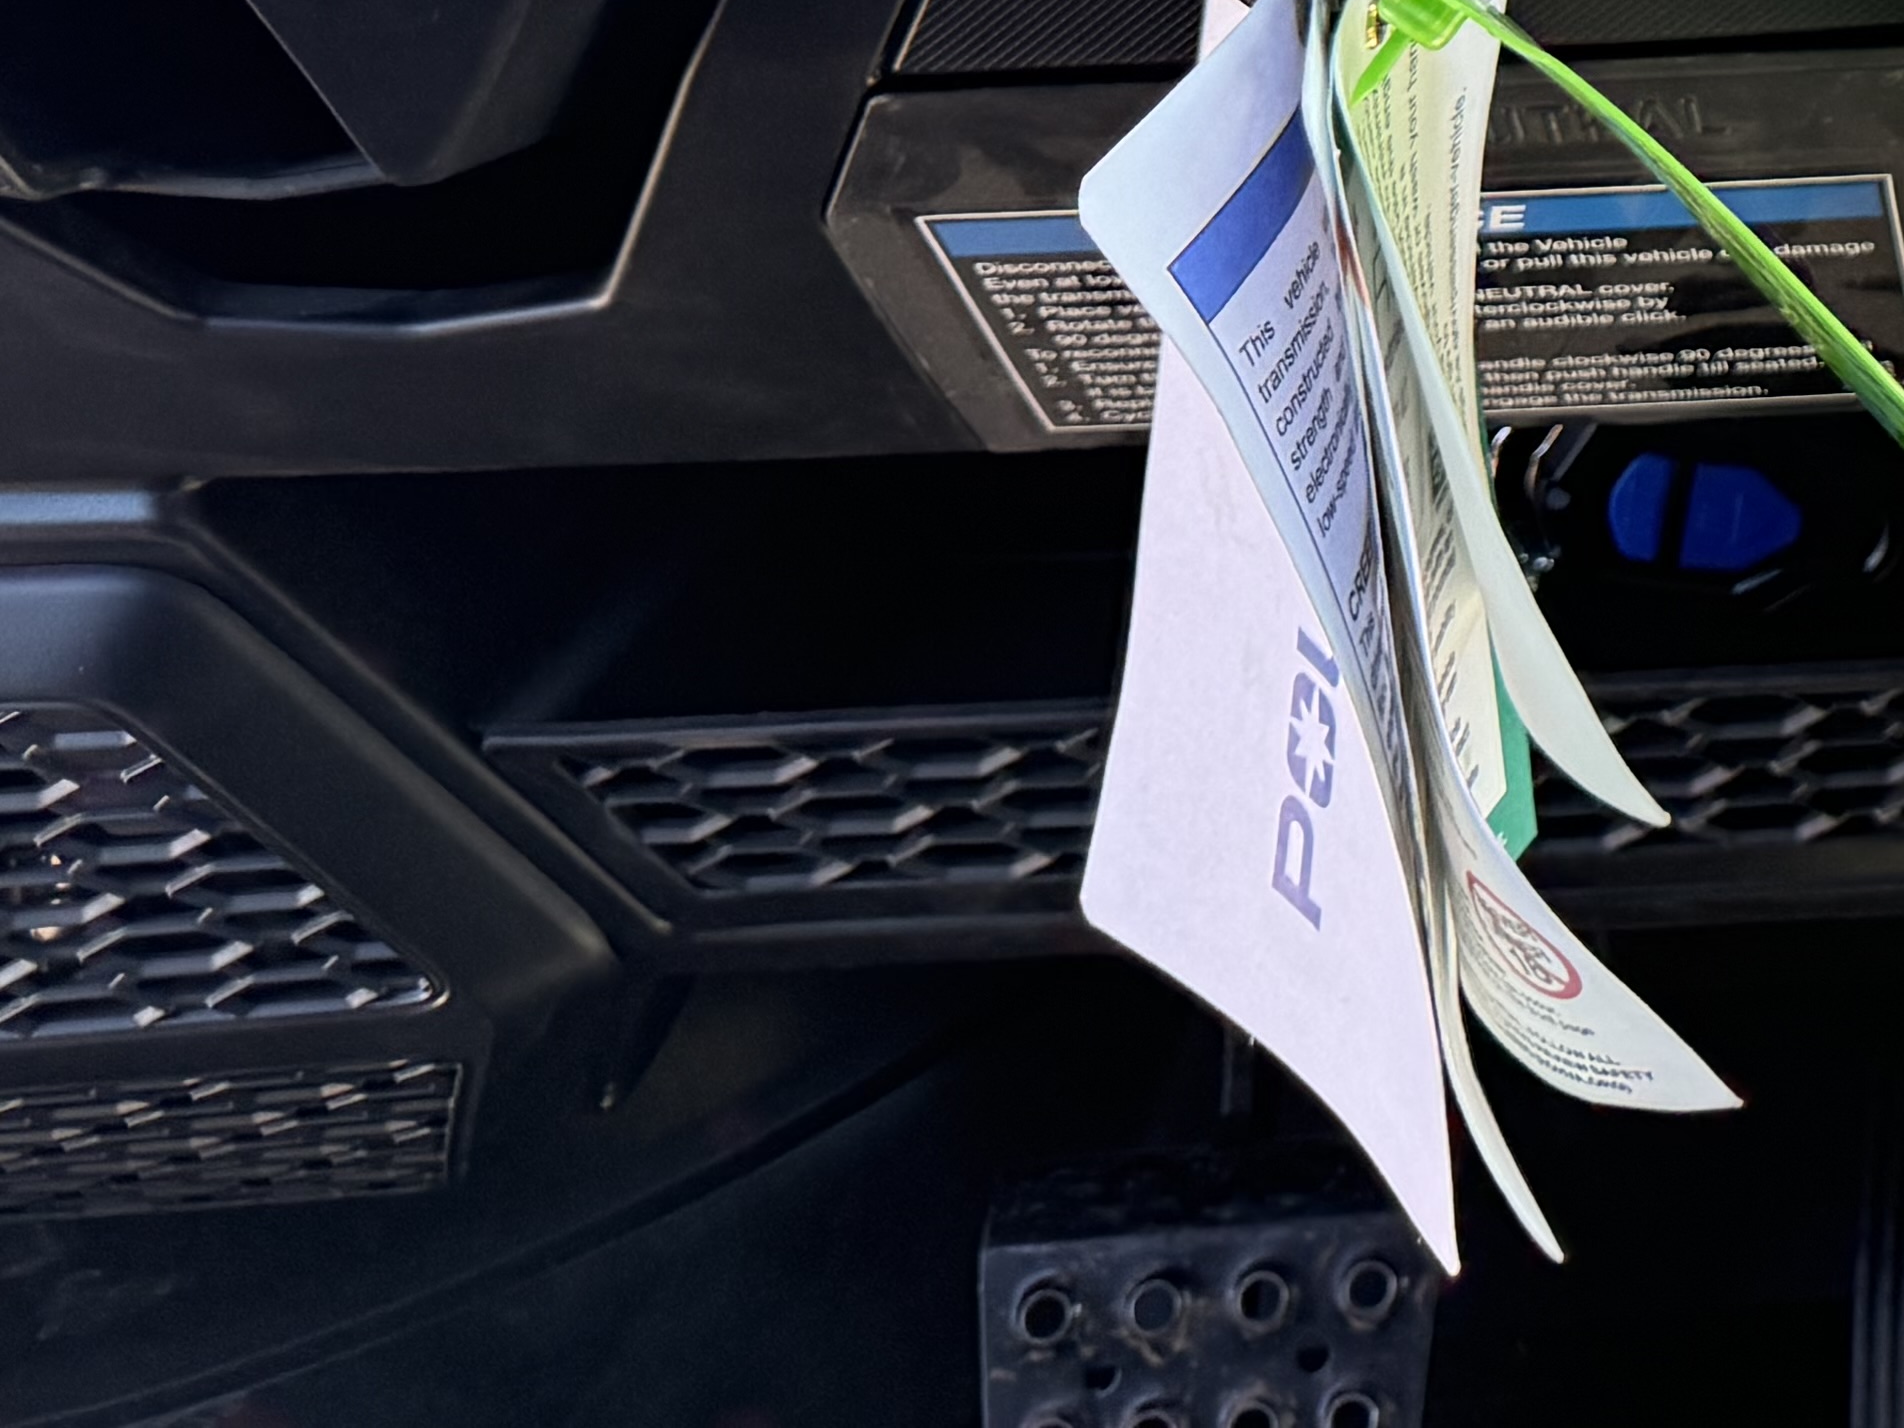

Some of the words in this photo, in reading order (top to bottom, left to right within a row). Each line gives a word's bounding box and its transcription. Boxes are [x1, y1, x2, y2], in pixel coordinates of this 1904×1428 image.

[974, 261, 1113, 276] Disconnec
[1534, 235, 1629, 253] Vehicle
[1482, 257, 1510, 270] or
[1515, 254, 1563, 271] pull
[1567, 252, 1617, 267] this
[1622, 247, 1713, 264] vehicle
[1774, 241, 1876, 256] damage
[1038, 289, 1137, 304] transm
[1239, 320, 1275, 367] This
[1284, 241, 1320, 310] vehicle
[1475, 297, 1631, 316] terclockwise
[1637, 295, 1669, 310] by
[1483, 318, 1516, 330] an
[1522, 312, 1615, 328] audible
[1276, 316, 1334, 436] constructed
[1291, 387, 1333, 471] strength
